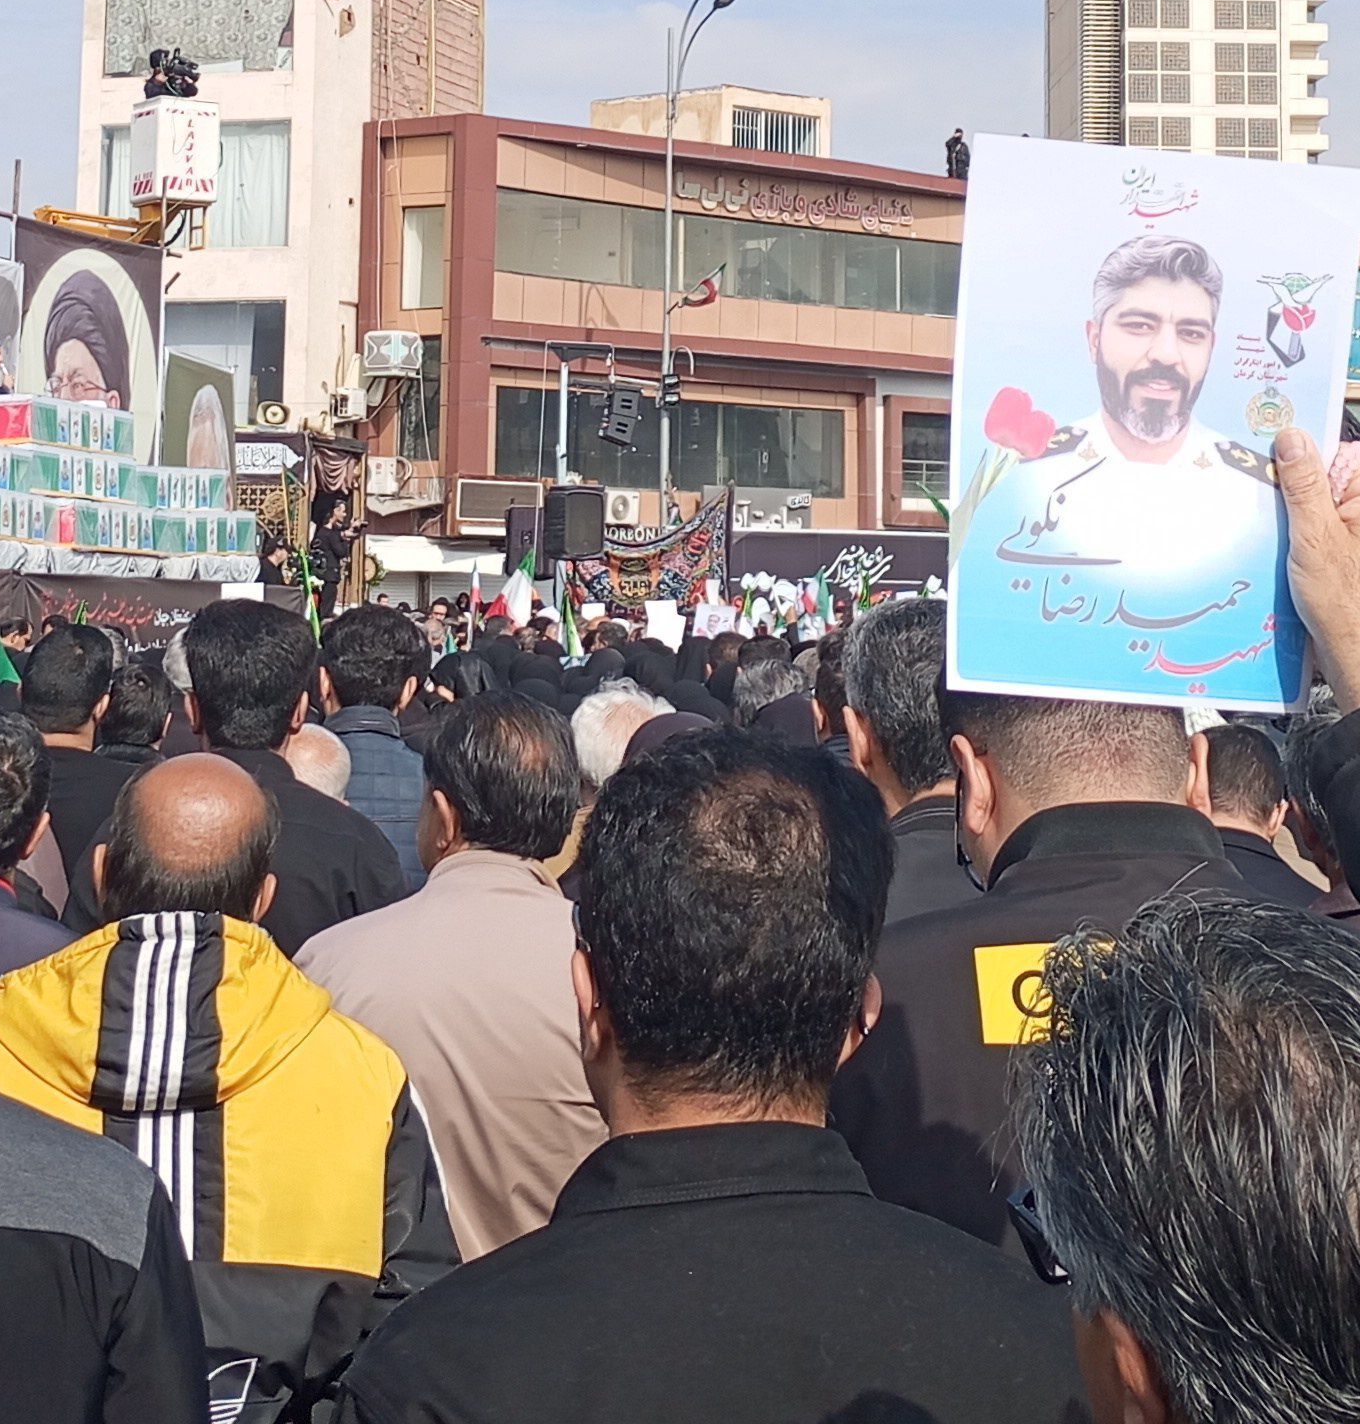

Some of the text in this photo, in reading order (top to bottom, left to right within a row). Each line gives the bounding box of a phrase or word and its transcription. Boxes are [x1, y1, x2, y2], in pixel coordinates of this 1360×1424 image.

[750, 183, 794, 222] بازی
[793, 195, 808, 222] و
[809, 187, 861, 225] شادی
[860, 196, 914, 232] دنیای
[1143, 612, 1277, 694] شهید
